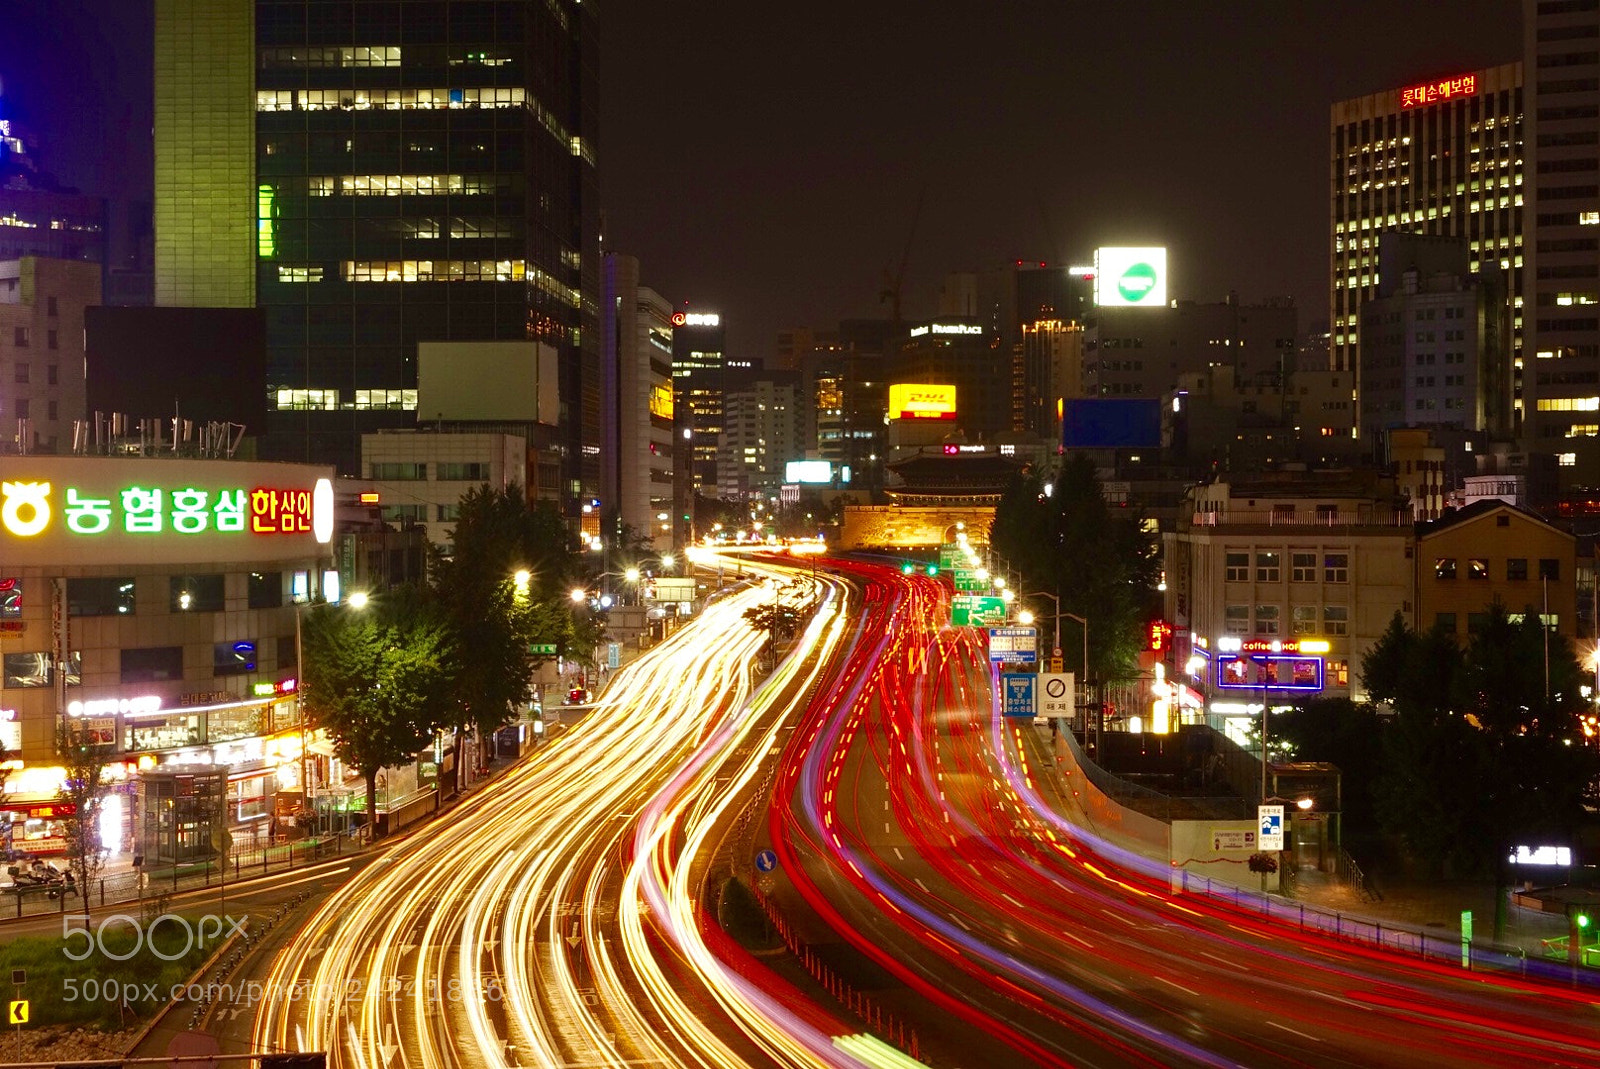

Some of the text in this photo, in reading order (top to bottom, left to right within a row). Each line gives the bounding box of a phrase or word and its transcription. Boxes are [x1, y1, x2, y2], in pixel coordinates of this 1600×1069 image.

[1402, 75, 1475, 107] 롯데손해보험
[64, 487, 311, 534] 농협홍삼 한삼인
[1242, 642, 1271, 650] coffee
